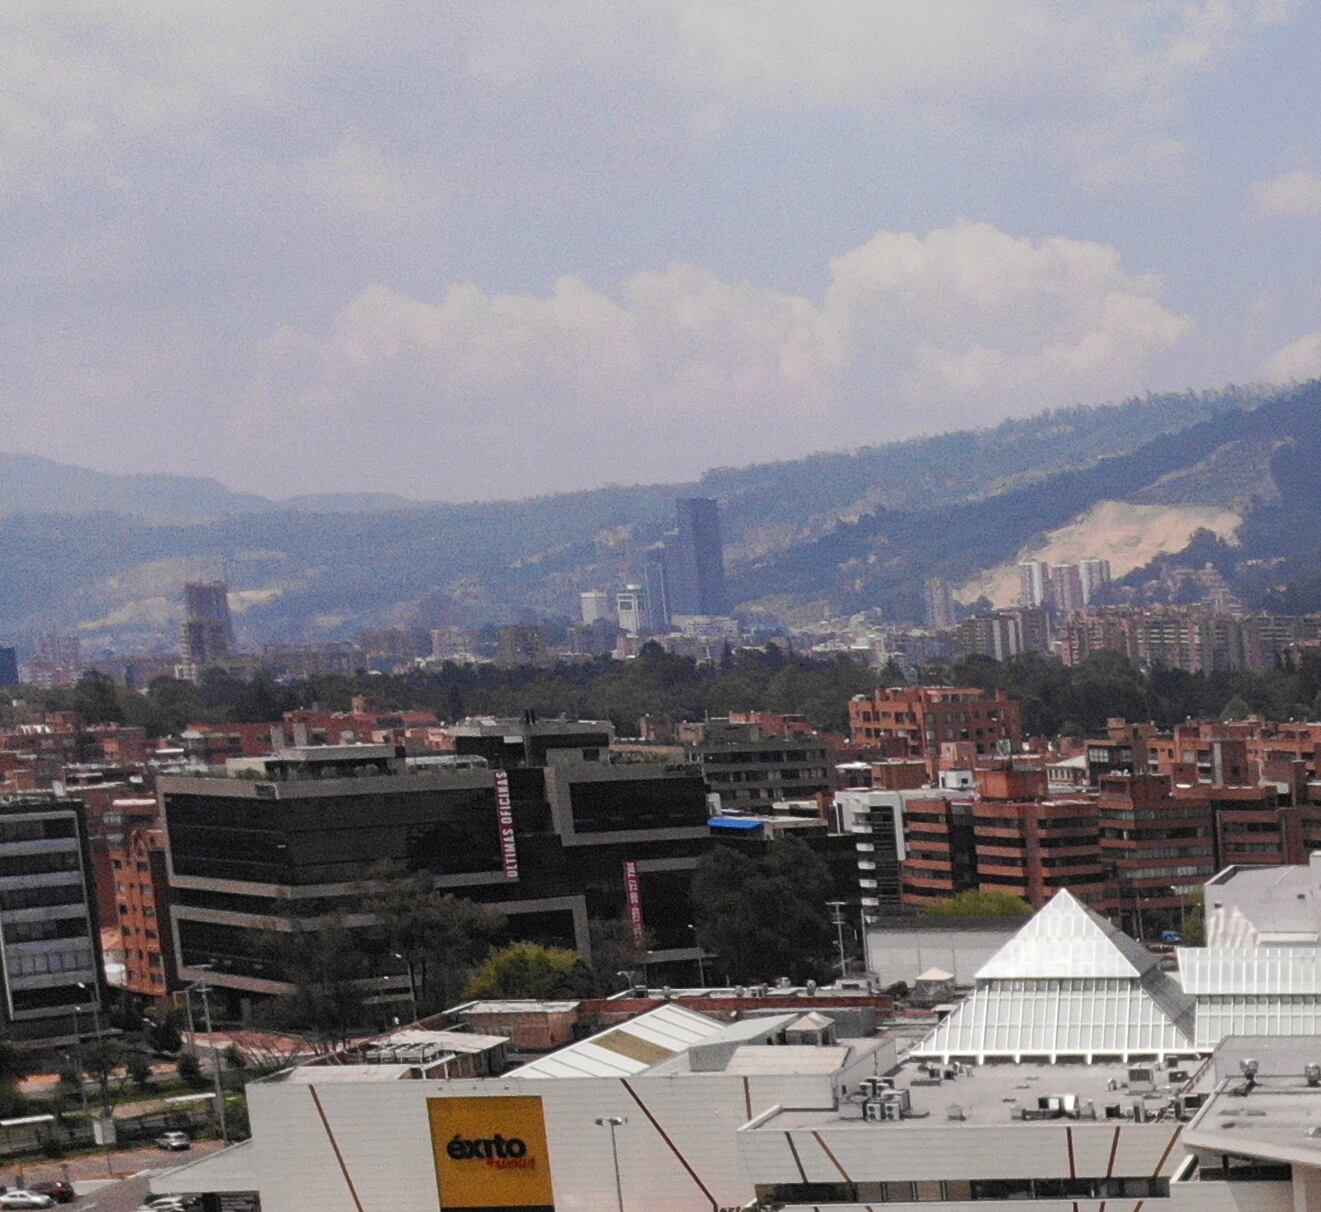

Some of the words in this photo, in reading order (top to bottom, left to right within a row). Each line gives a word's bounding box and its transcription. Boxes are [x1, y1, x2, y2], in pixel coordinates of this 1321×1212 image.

[495, 771, 513, 825] OFICINAS
[502, 828, 518, 878] ULTIMAS
[446, 1134, 527, 1160] éxito
